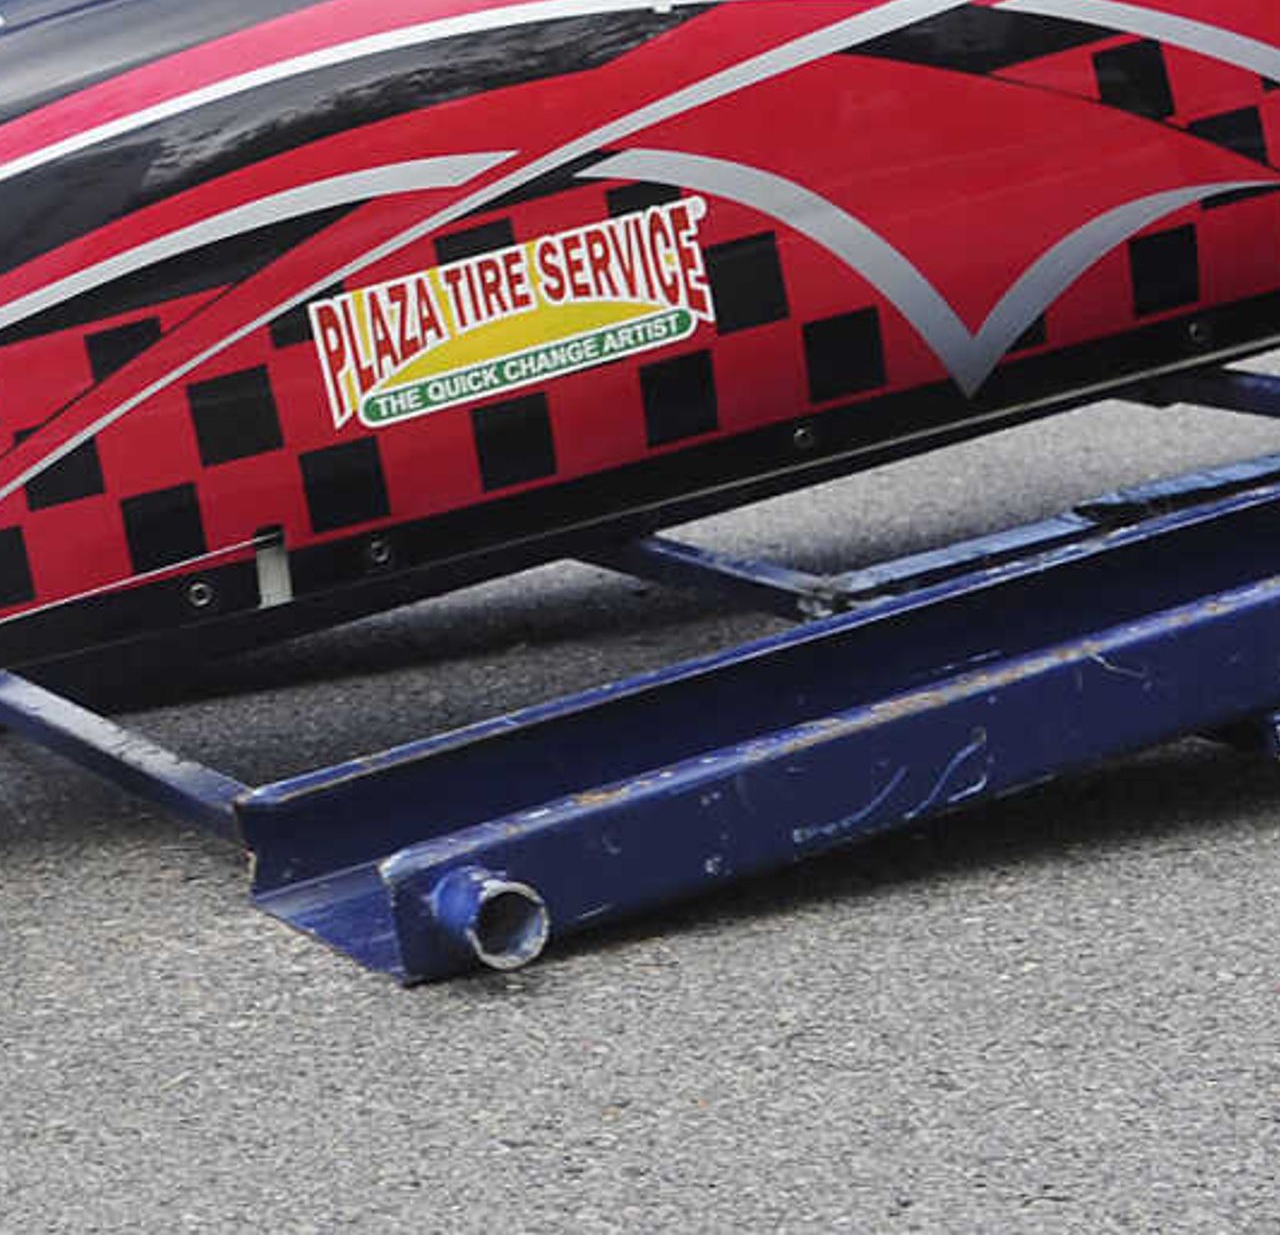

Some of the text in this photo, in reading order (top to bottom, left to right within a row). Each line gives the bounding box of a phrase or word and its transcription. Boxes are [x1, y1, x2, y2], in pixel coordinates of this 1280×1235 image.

[314, 205, 710, 420] PLAZA TIRE SERVICE
[376, 312, 682, 418] THE QUICK CHANGE ARTIST
